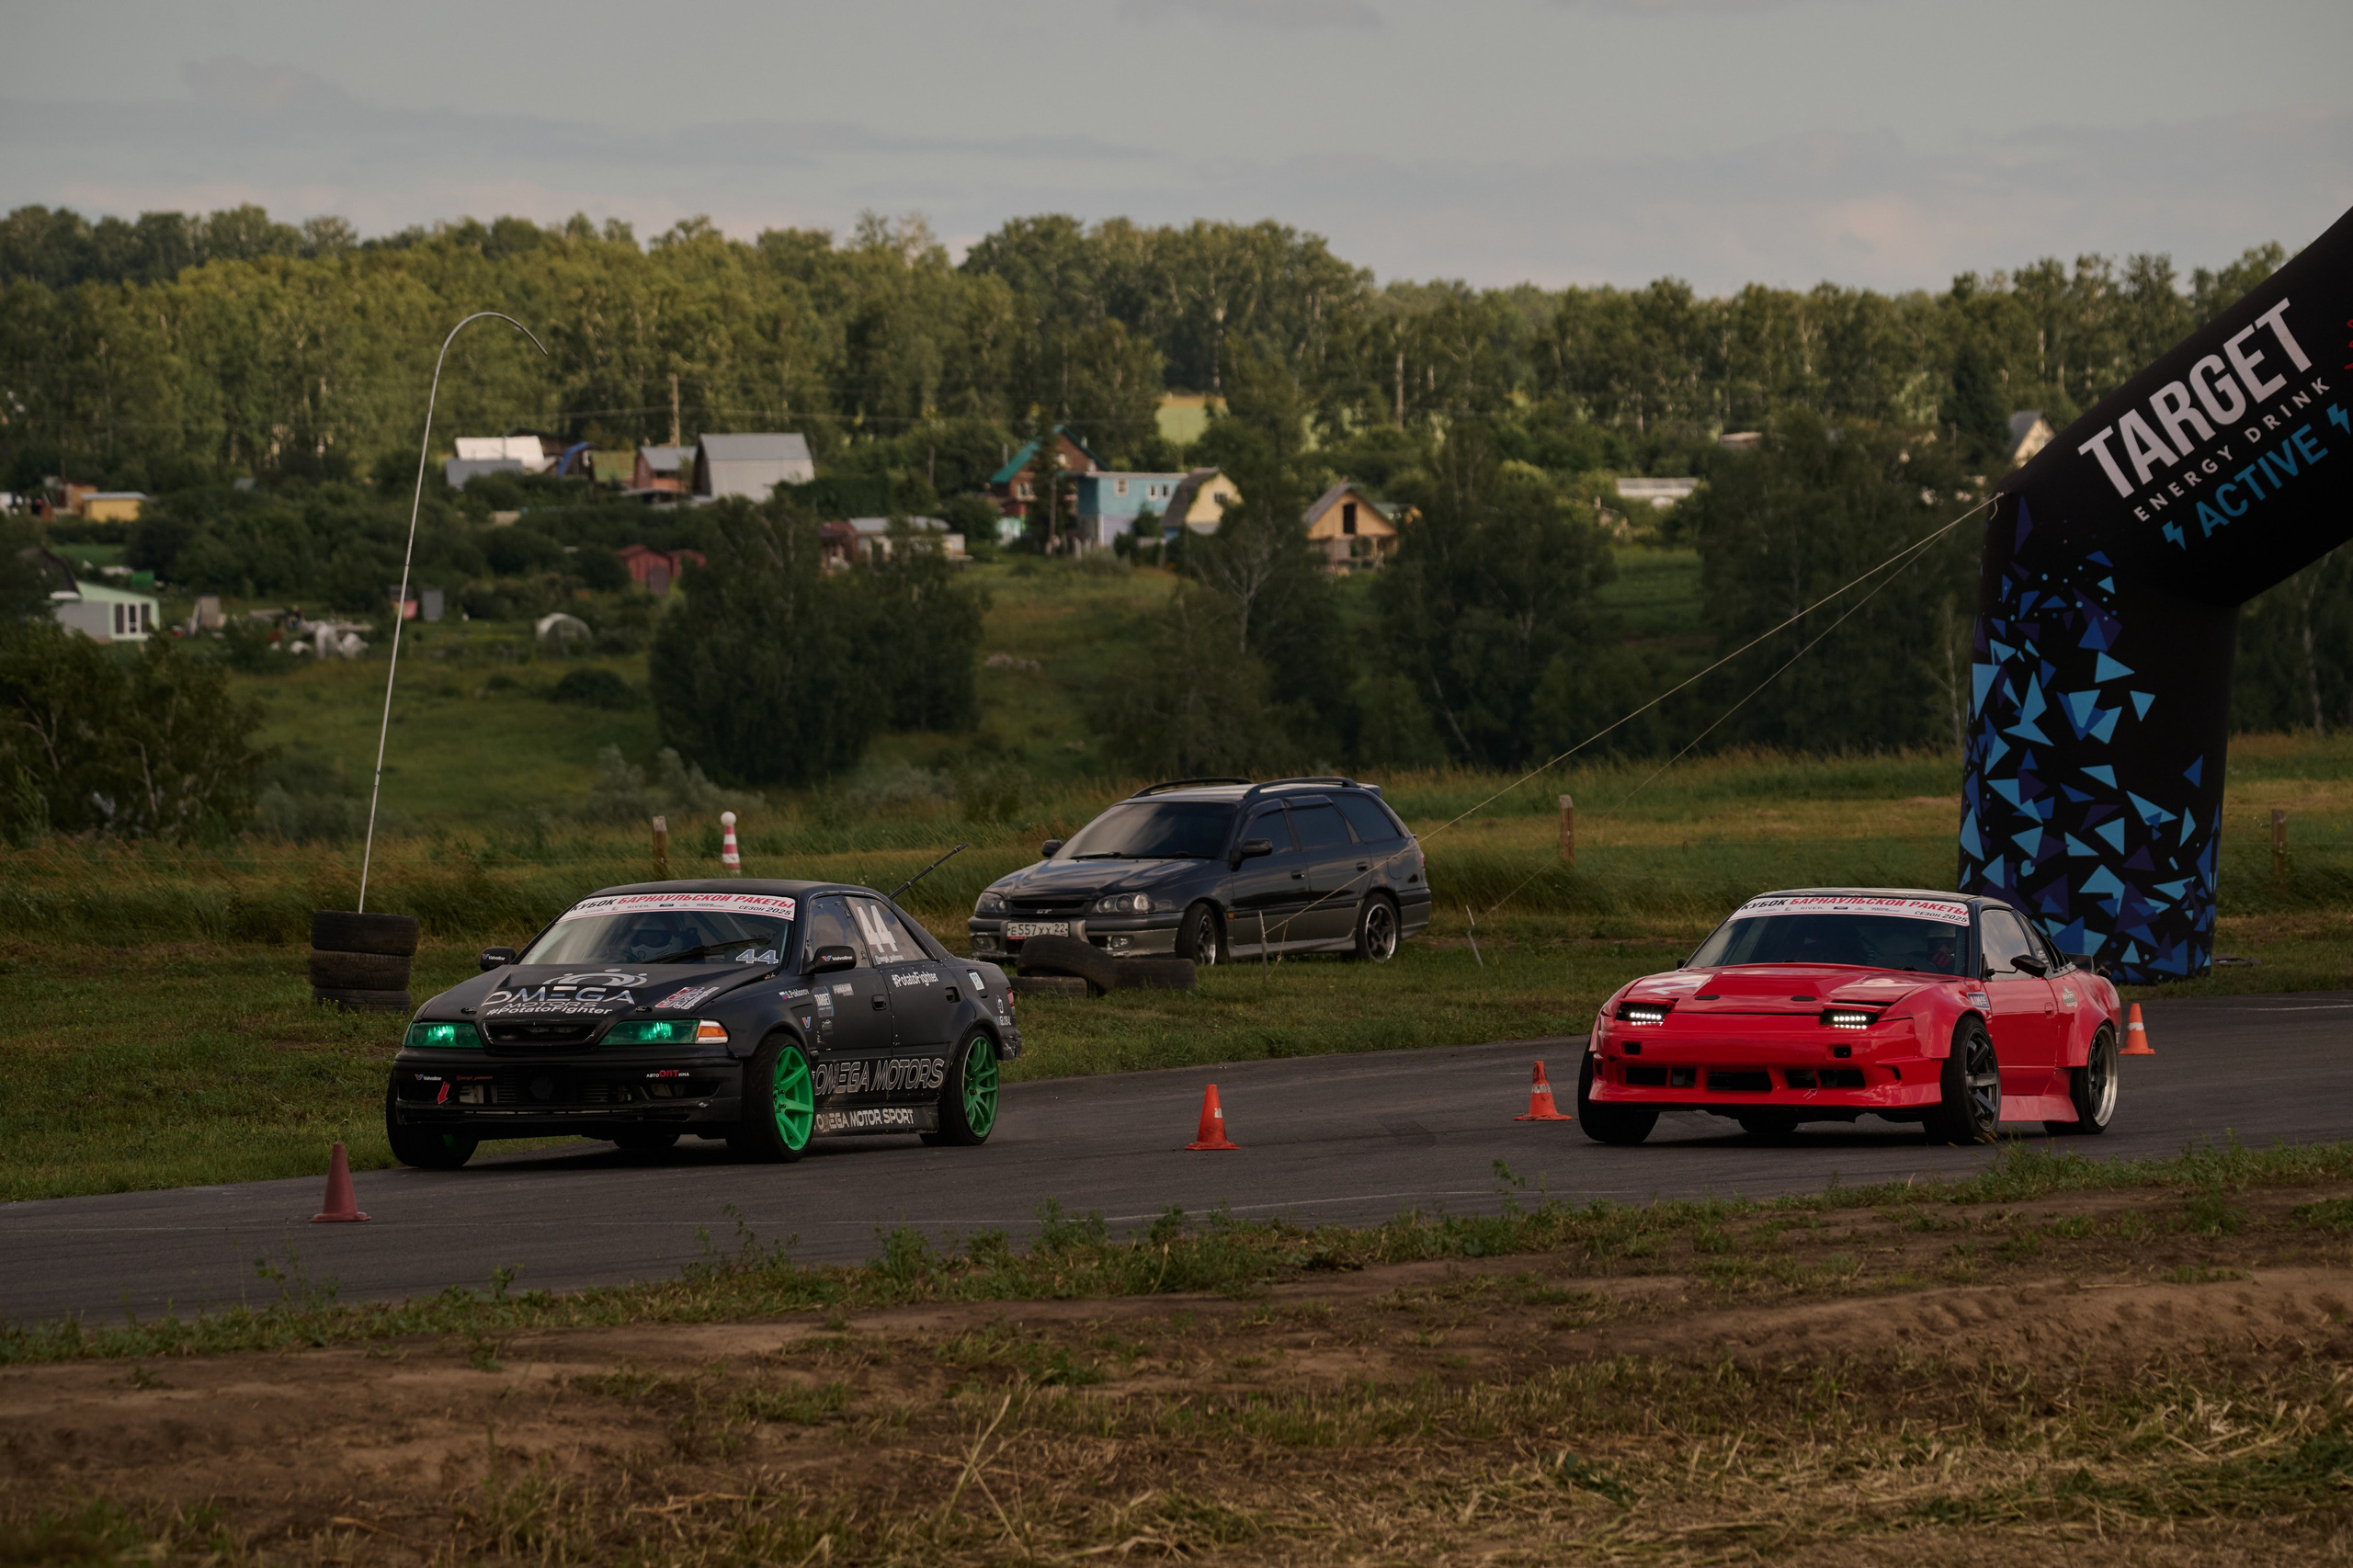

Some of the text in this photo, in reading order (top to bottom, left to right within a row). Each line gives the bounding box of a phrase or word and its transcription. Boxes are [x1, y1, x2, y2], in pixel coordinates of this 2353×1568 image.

[2078, 297, 2313, 499] TARGET
[2133, 377, 2331, 522] ENERGY DRINK
[2195, 424, 2329, 538] ACTIVE
[570, 893, 795, 912] КУБОК БАРНАУЛЬСКОЙ РАКЕТЫ
[765, 906, 792, 916] 2025
[1740, 899, 1789, 911] КУБОК
[1789, 897, 1906, 906] БАРНАУЛЬСКОЙ
[1908, 901, 1969, 915] РАКЕТЫ
[1942, 913, 1968, 923] 2025
[857, 904, 899, 953] 44
[1054, 923, 1065, 933] 22
[735, 949, 779, 964] 44
[891, 971, 939, 988] #PotatoFighter
[481, 985, 636, 1007] OMEGA
[503, 1001, 599, 1009] MOTORS
[486, 1006, 613, 1017] #PotatoFighter
[814, 1061, 870, 1096] OMEGA
[870, 1058, 946, 1092] MOTORS
[815, 1108, 915, 1131] OMEGA MOTOR SPORT
